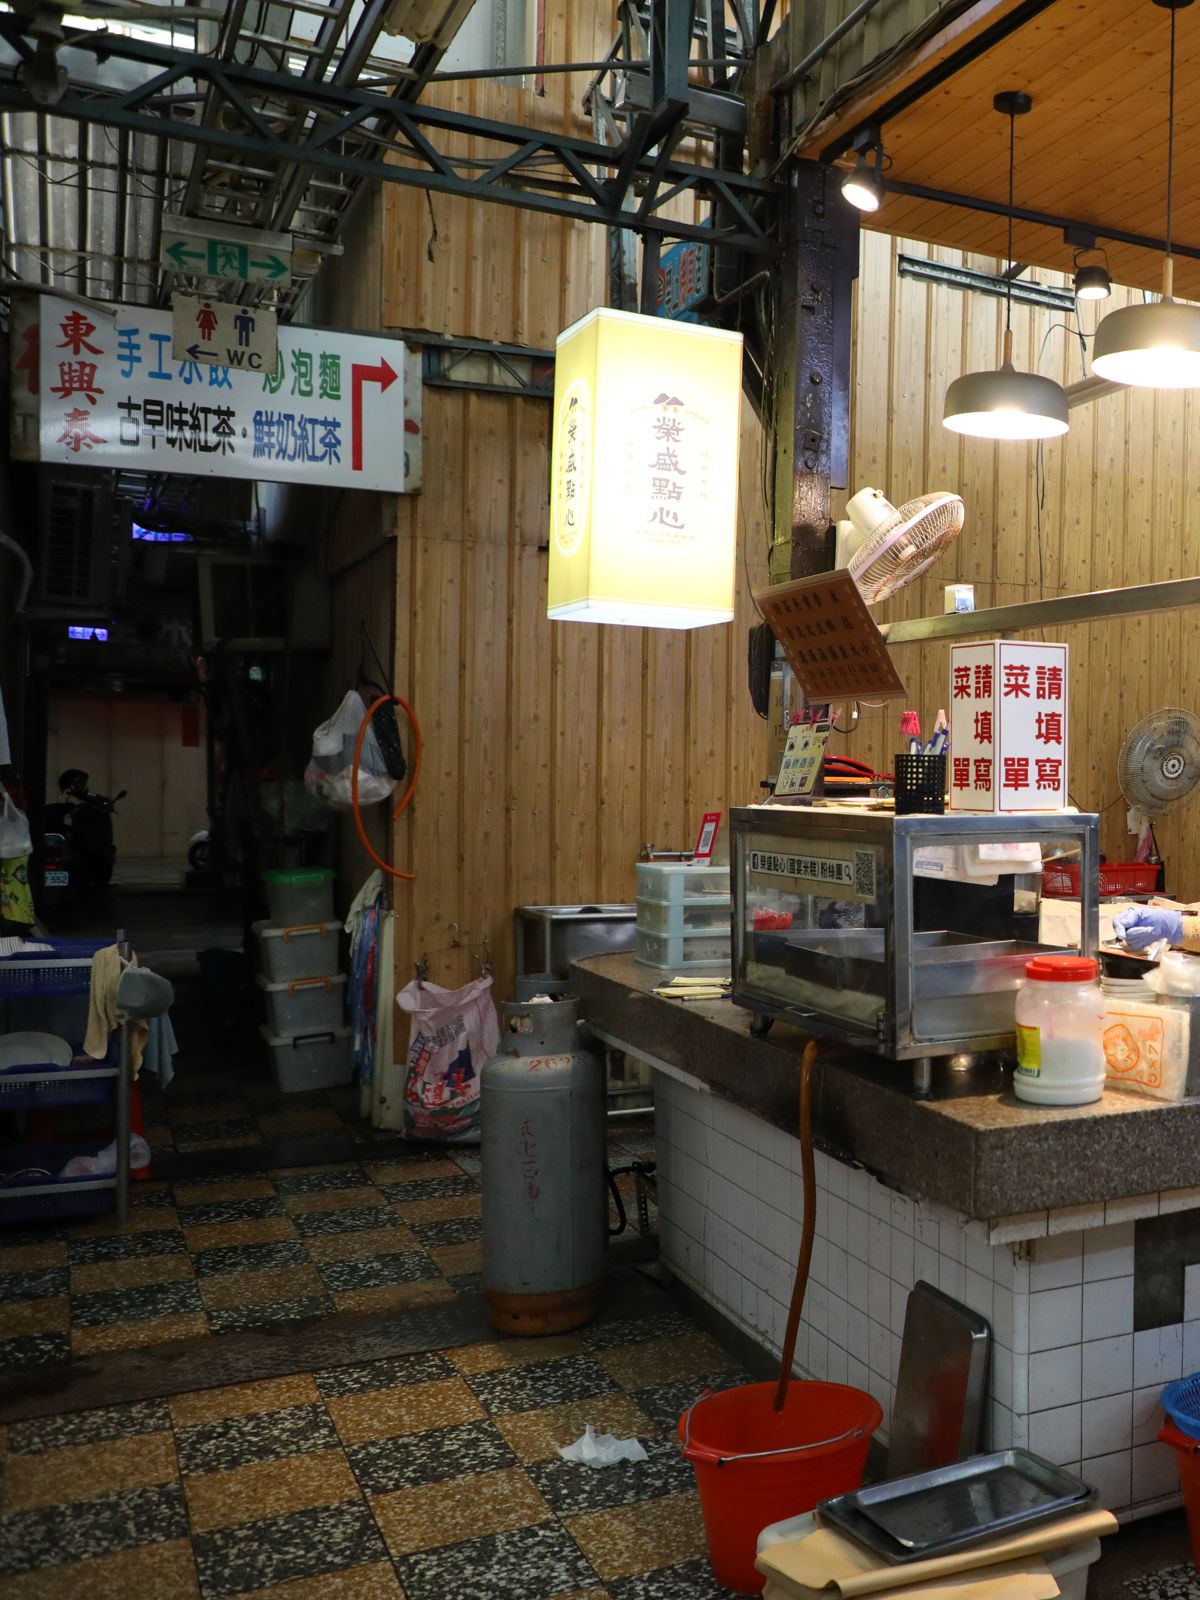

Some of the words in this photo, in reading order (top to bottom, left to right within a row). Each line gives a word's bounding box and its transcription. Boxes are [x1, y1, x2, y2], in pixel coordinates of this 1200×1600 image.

[50, 310, 107, 453] 東興泰
[226, 347, 263, 370] WC
[117, 395, 236, 455] 古早味紅茶
[252, 410, 342, 464] 鮮奶紅茶
[648, 416, 687, 530] 榮盛點心
[953, 666, 972, 791] 菜單
[974, 664, 993, 792] 請填寫
[1003, 664, 1031, 791] 菜單
[1034, 665, 1063, 792] 請填寫
